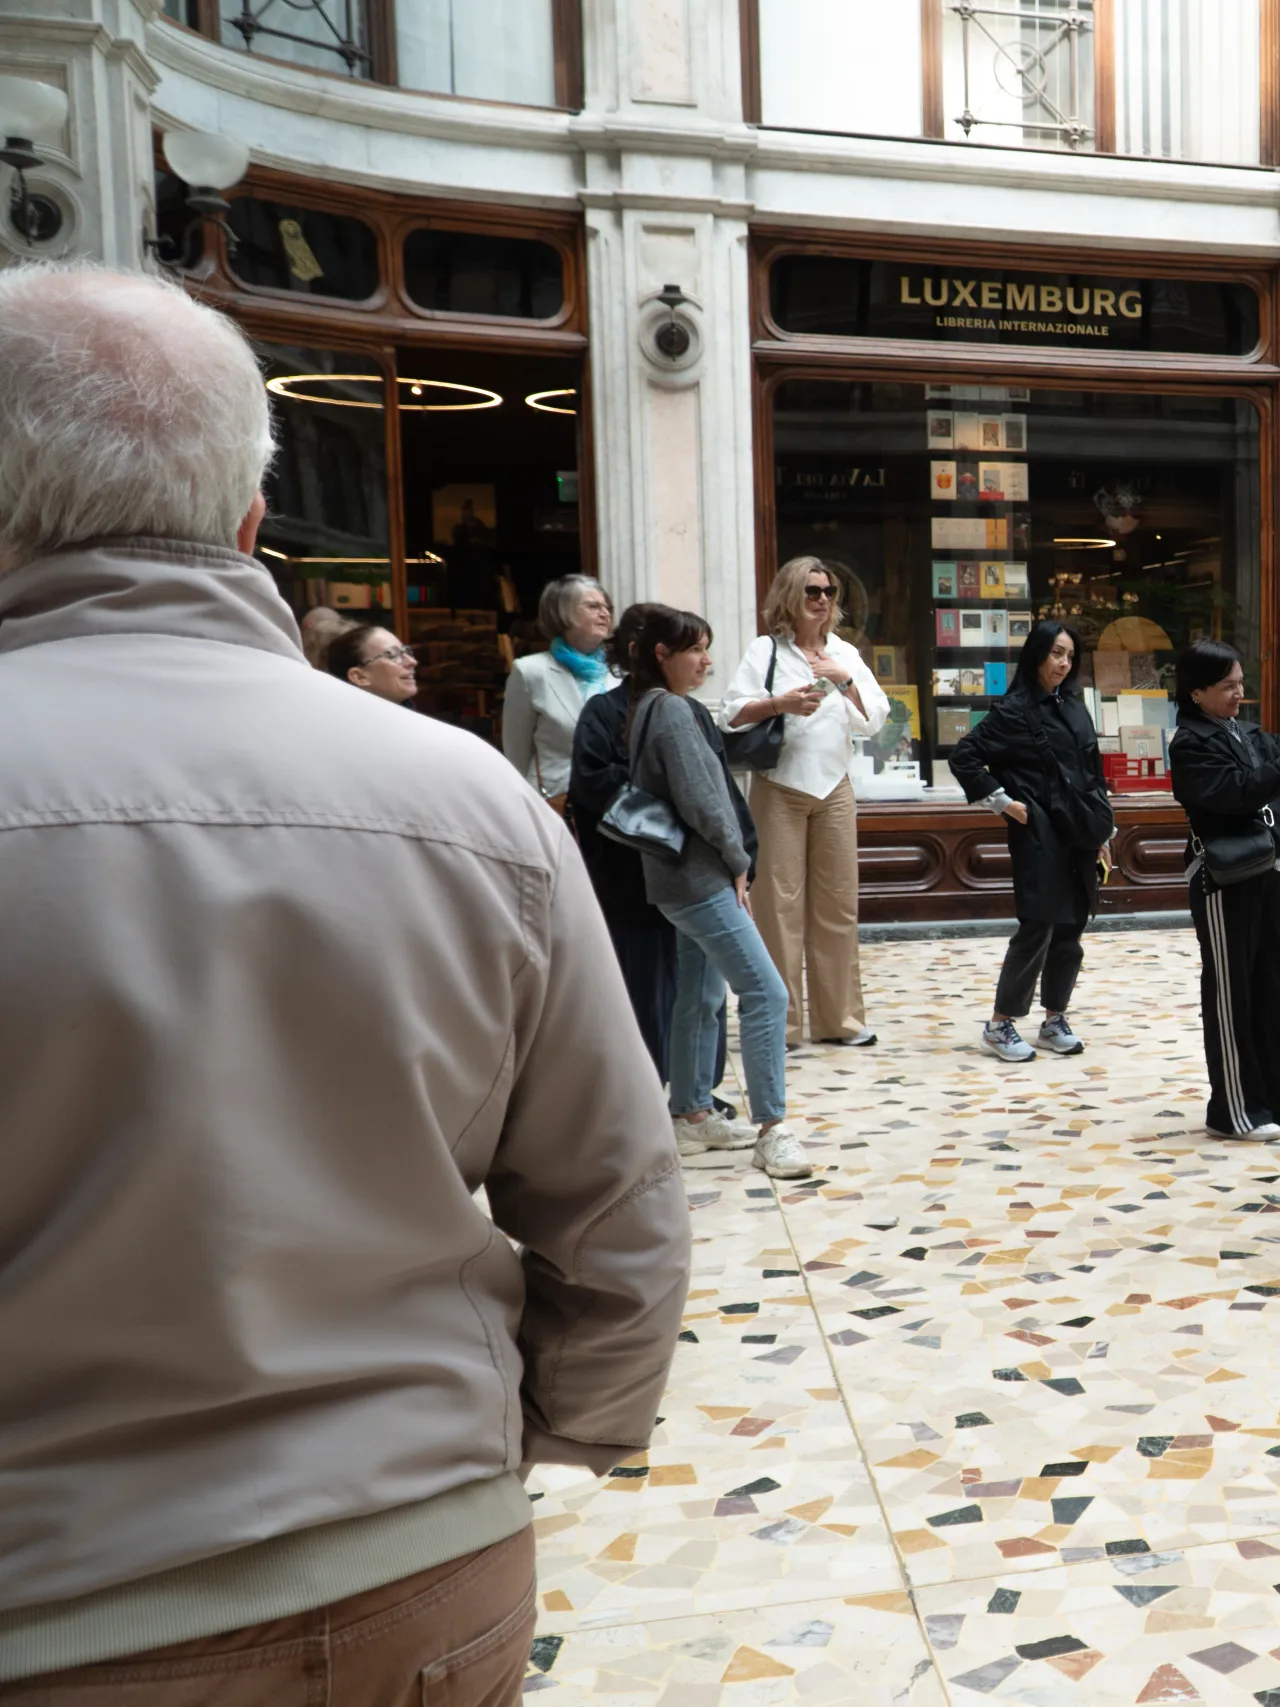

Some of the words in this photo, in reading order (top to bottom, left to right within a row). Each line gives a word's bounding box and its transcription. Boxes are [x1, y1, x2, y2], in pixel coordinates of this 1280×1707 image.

[900, 276, 1143, 319] LUXEMBURG
[936, 316, 996, 330] LIBRERIA
[998, 319, 1109, 336] INTERNAZIONALE
